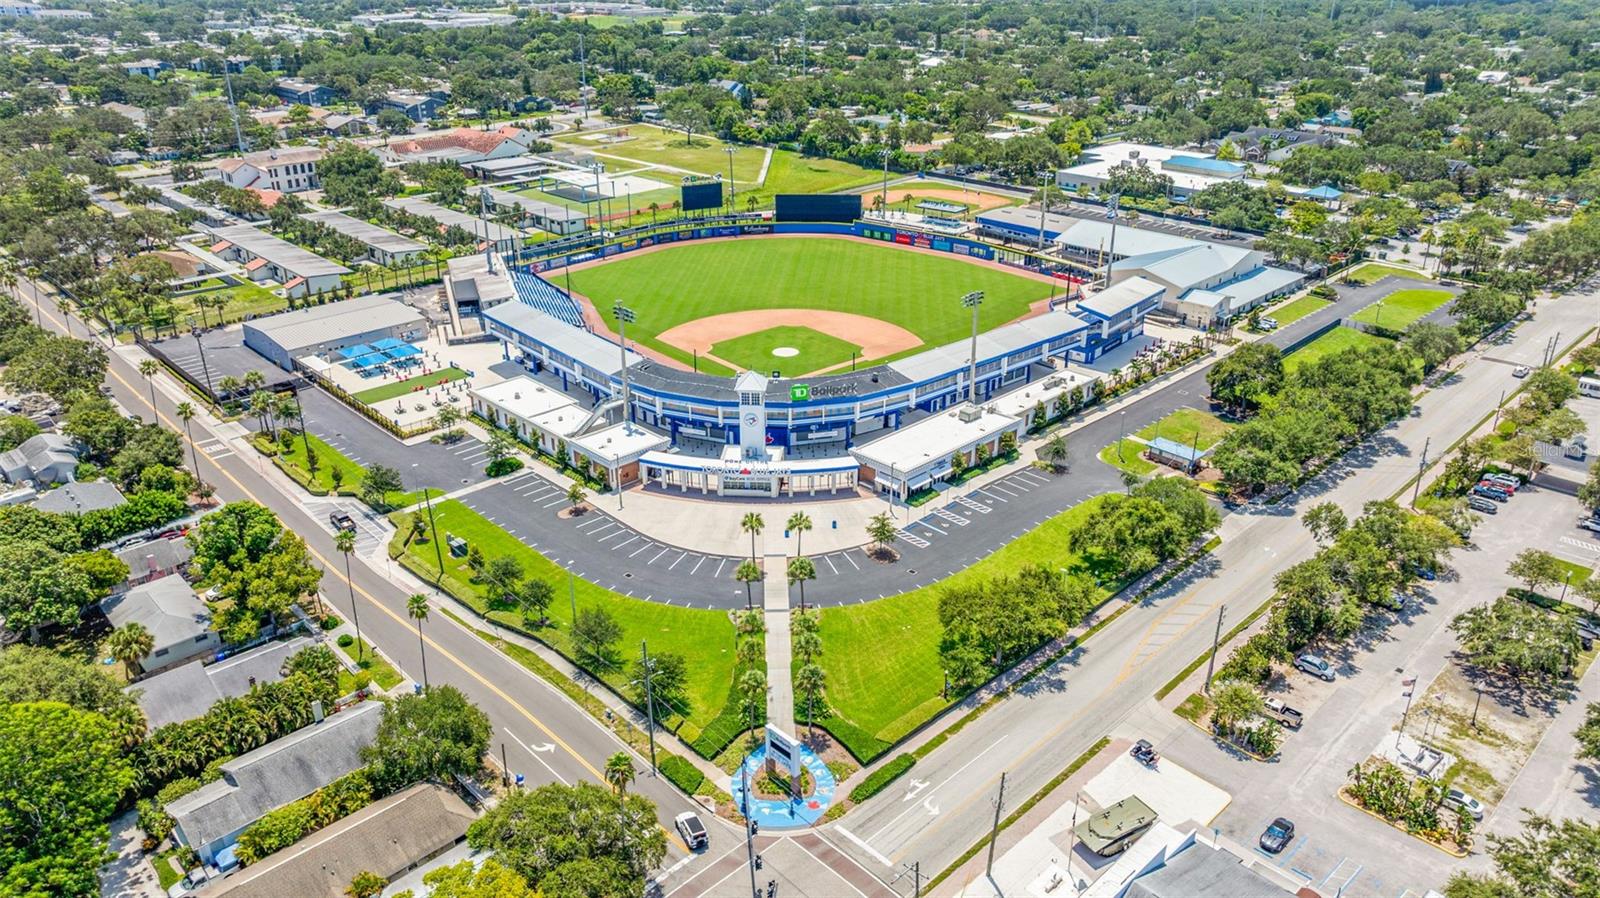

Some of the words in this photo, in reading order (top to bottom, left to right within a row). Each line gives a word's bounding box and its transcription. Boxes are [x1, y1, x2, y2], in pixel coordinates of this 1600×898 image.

[811, 383, 858, 396] Ballpark
[702, 465, 741, 475] TORONTO
[751, 467, 769, 475] BLUE
[770, 467, 791, 475] JAYS
